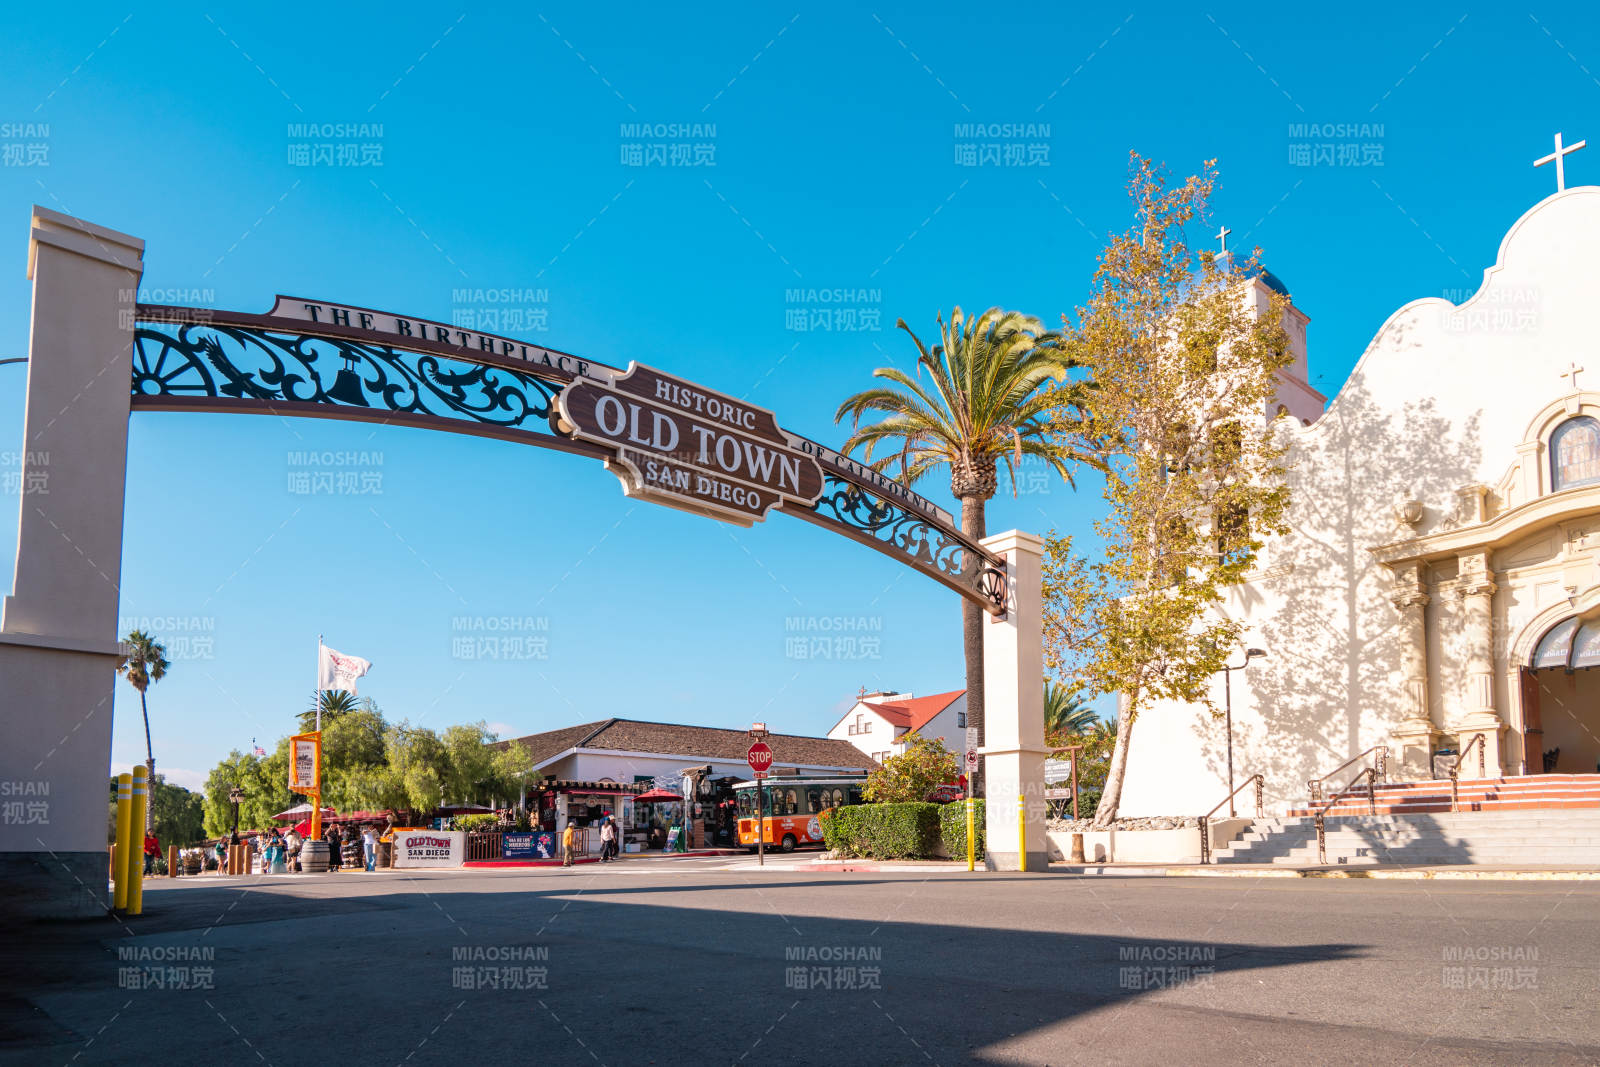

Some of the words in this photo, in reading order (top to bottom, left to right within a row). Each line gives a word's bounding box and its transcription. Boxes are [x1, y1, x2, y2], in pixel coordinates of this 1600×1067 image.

[304, 304, 377, 331] THE
[395, 318, 590, 377] BIRTHPLACE
[655, 378, 757, 431] HISTORIC
[595, 395, 679, 452] OLD
[692, 424, 801, 496] TOWN
[646, 461, 690, 491] SAN
[695, 473, 761, 510] DIEGO
[801, 439, 826, 459] OF
[834, 455, 939, 516] CALIFORNIA
[750, 752, 771, 763] STOP
[406, 837, 425, 848] OLD
[425, 836, 451, 848] TOWN
